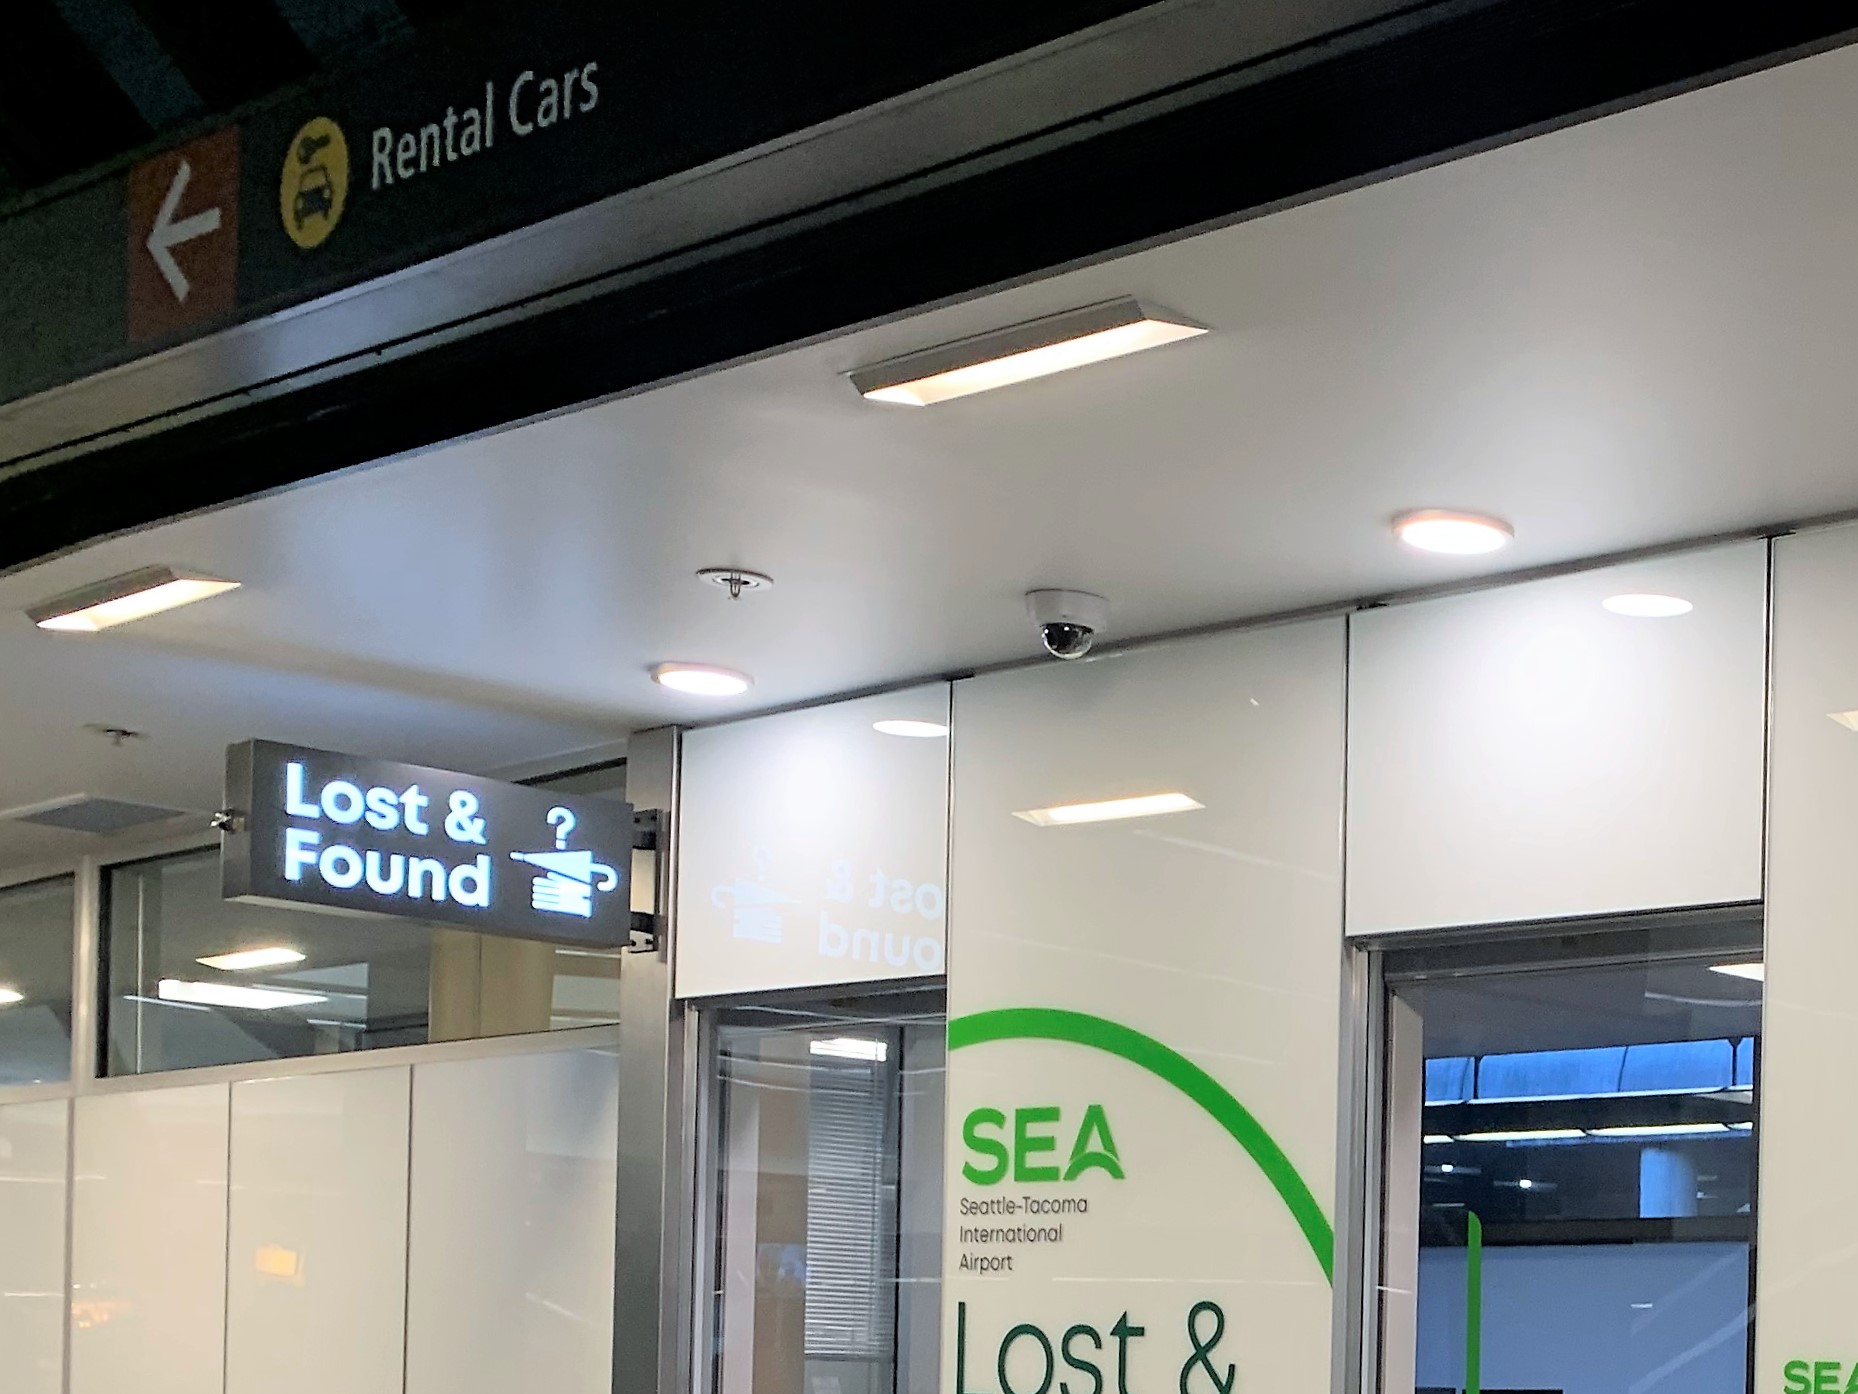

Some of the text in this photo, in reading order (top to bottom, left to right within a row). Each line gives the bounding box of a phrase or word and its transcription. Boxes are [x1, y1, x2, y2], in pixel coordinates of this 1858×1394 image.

[372, 62, 598, 189] Rental Cars
[285, 761, 488, 845] Lost &
[284, 828, 492, 909] Found
[962, 1104, 1125, 1186] SEA
[960, 1196, 1087, 1215] Seattle-Tacoma
[960, 1224, 1062, 1243] International
[959, 1254, 1012, 1275] Airport
